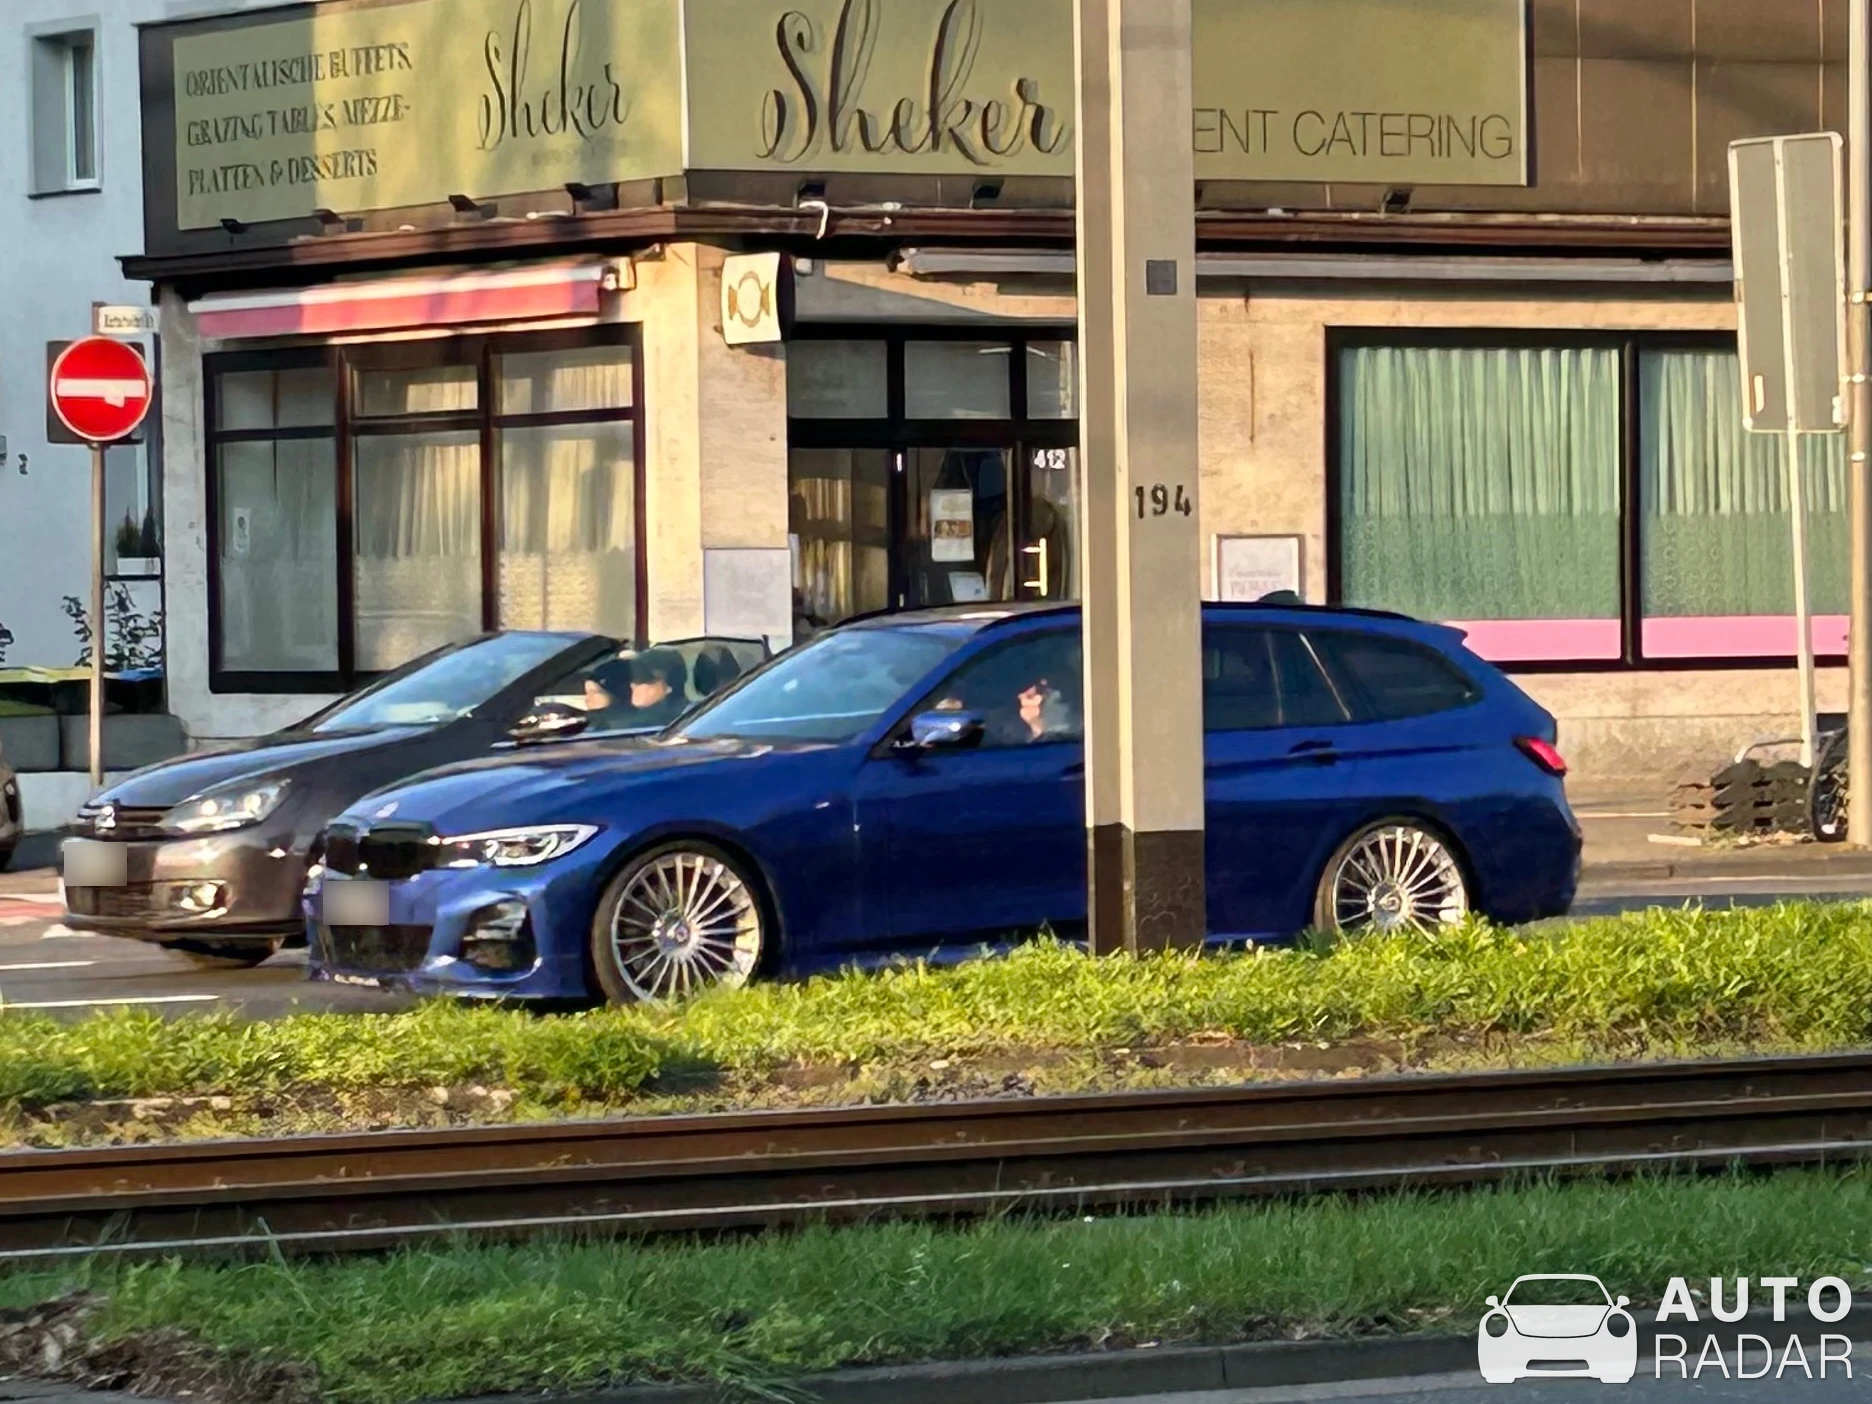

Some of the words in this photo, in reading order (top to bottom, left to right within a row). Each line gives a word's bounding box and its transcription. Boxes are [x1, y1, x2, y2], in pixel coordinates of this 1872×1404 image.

[472, 0, 632, 155] Sheker
[755, 0, 1065, 166] Sheker
[1293, 109, 1513, 159] CATERING
[1135, 483, 1192, 519] 194
